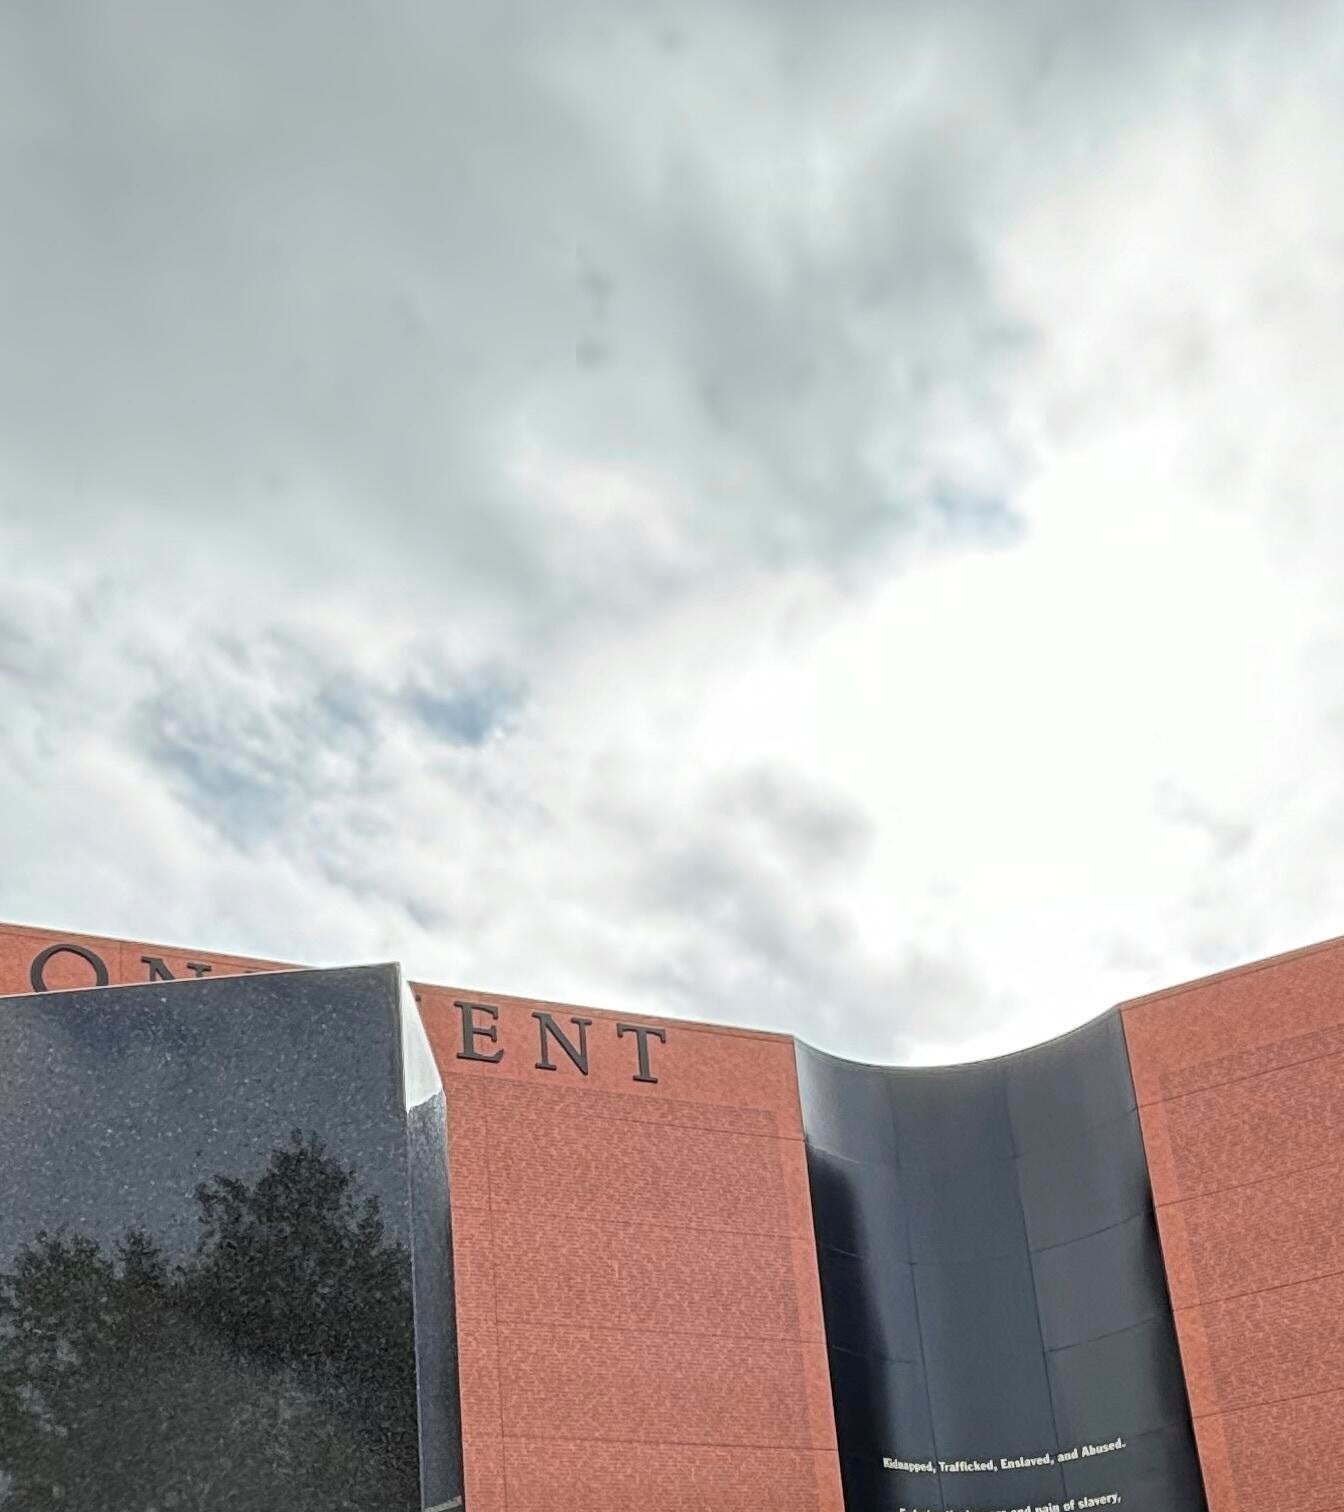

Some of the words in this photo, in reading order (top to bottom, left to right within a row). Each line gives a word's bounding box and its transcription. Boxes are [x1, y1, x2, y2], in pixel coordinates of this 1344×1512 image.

[882, 1457, 936, 1474] Kidnapped,
[938, 1460, 998, 1472] Trafficked,
[1000, 1453, 1054, 1469] Enslaved,
[1057, 1448, 1078, 1462] and
[1081, 1437, 1126, 1458] Abused.
[1063, 1499, 1075, 1512] of
[1077, 1493, 1121, 1509] slavery,
